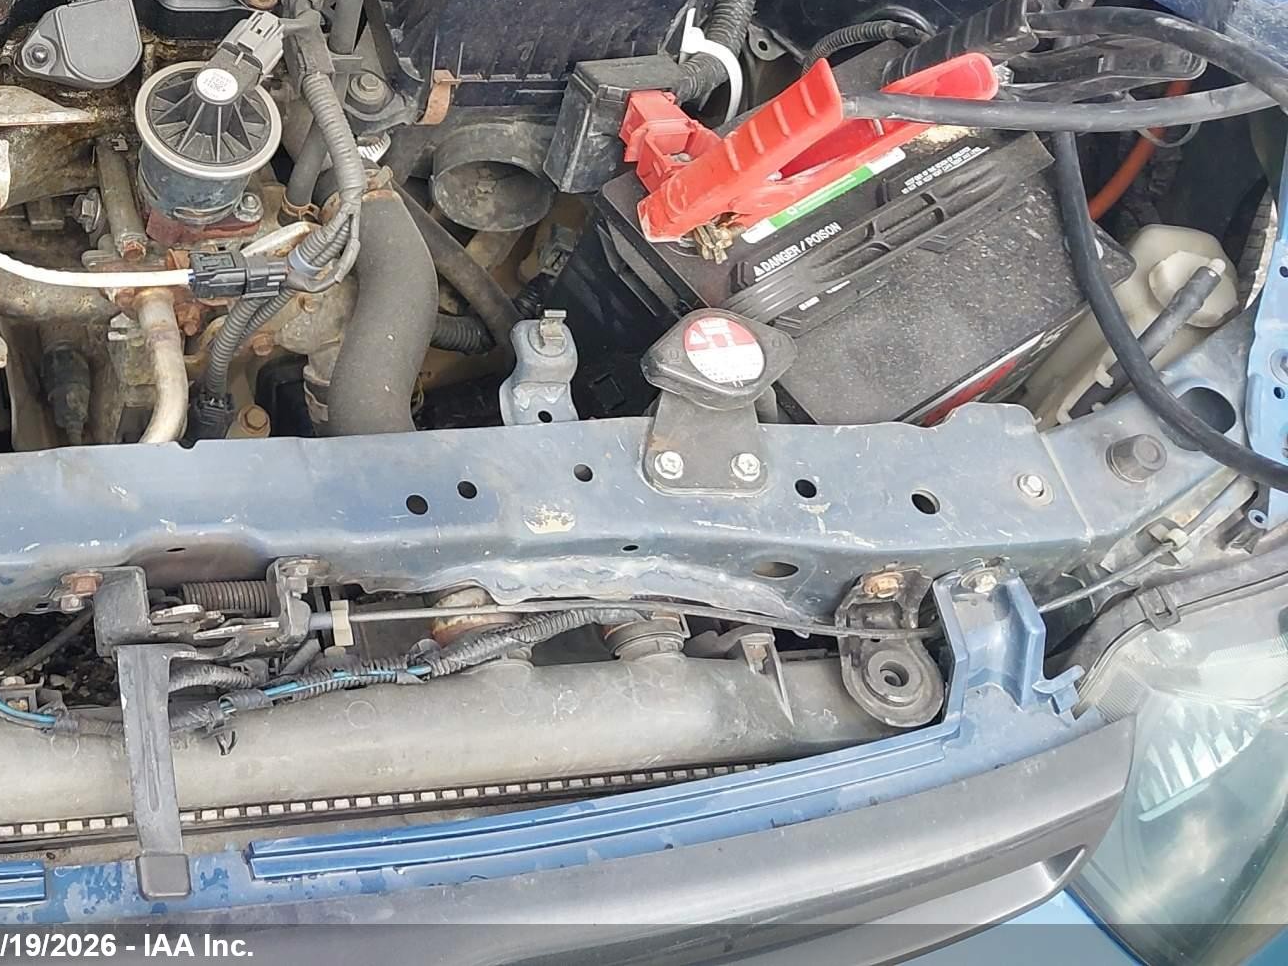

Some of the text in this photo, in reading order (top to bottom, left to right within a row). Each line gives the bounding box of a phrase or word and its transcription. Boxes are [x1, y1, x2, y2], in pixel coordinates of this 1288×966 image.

[759, 221, 842, 272] DANGER / POISON
